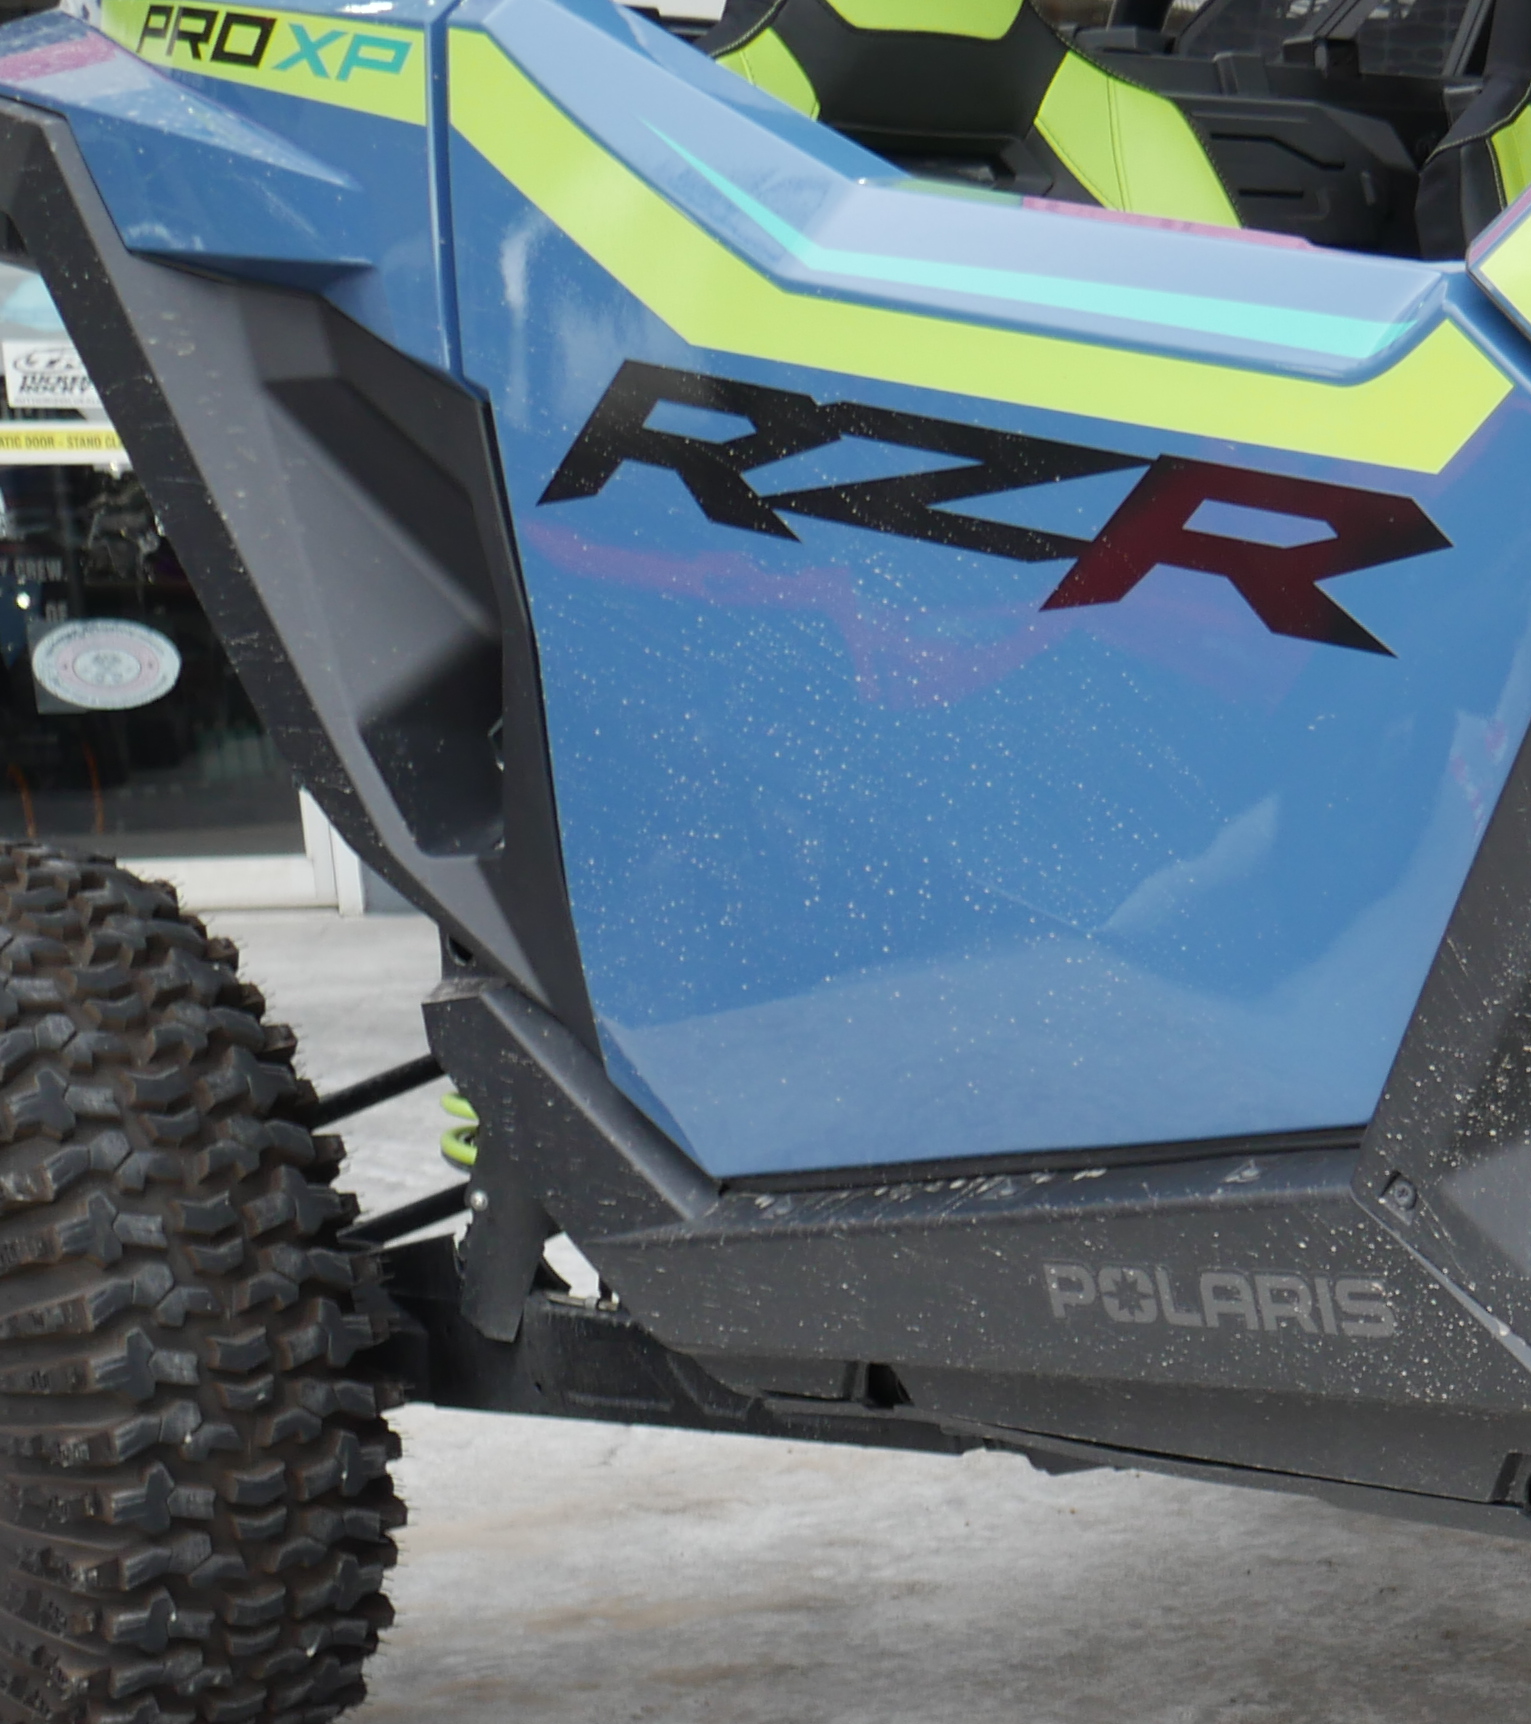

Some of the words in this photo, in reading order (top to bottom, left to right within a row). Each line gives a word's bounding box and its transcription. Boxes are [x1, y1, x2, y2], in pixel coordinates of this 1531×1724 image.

[136, 5, 277, 69] PRO
[272, 22, 413, 82] XP
[25, 435, 54, 449] DOOR
[67, 436, 101, 449] STAND
[537, 360, 1454, 658] RZR
[1043, 1260, 1396, 1339] POLARIS
